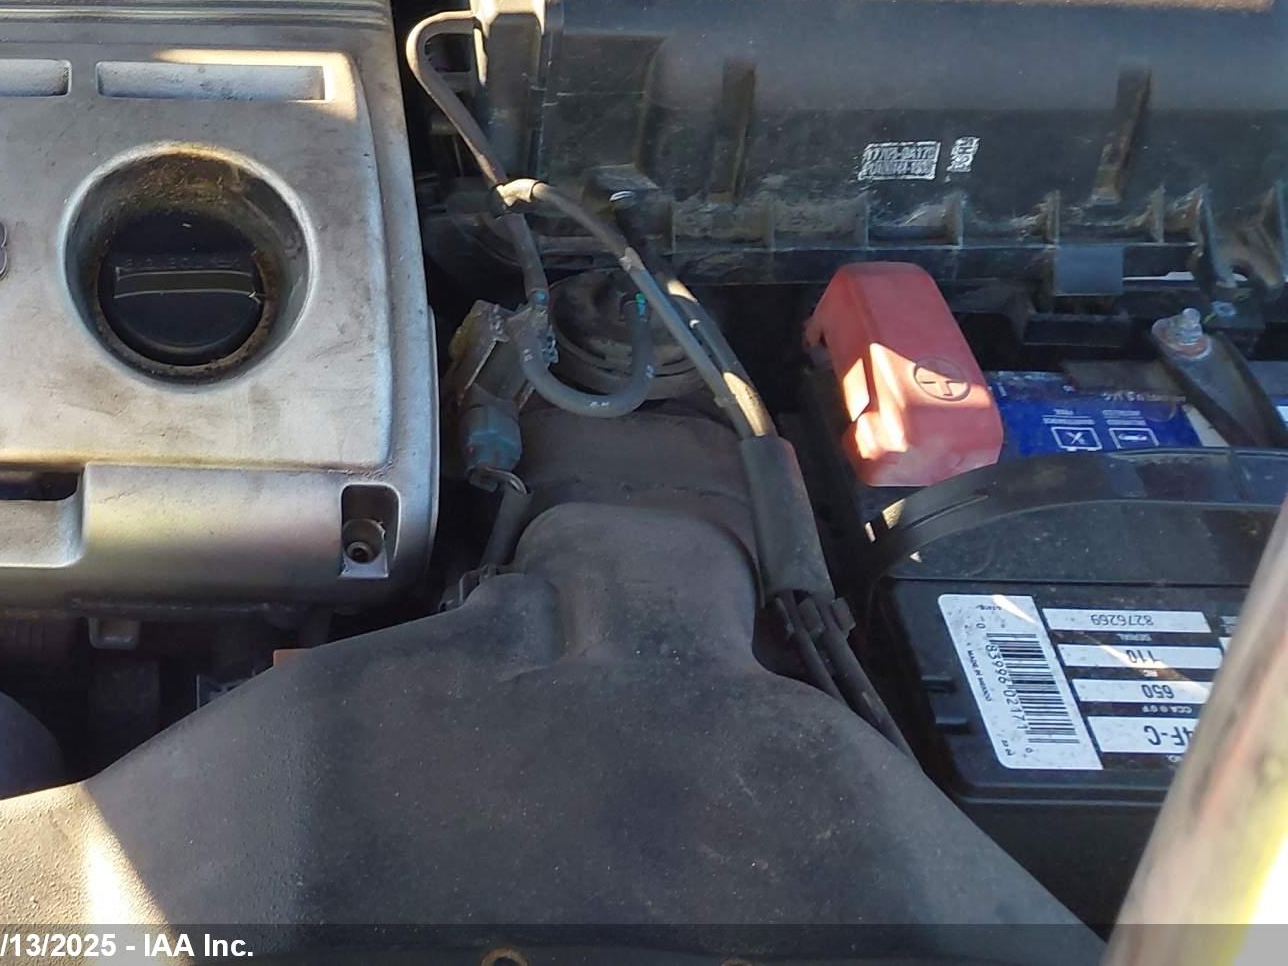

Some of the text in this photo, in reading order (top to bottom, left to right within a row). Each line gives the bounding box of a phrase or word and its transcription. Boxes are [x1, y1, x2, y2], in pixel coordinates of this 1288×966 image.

[1126, 649, 1161, 664] 110
[985, 644, 1013, 685] 83996
[1003, 689, 1029, 730] 02171
[1141, 684, 1175, 699] 650
[1171, 705, 1193, 714] CCA
